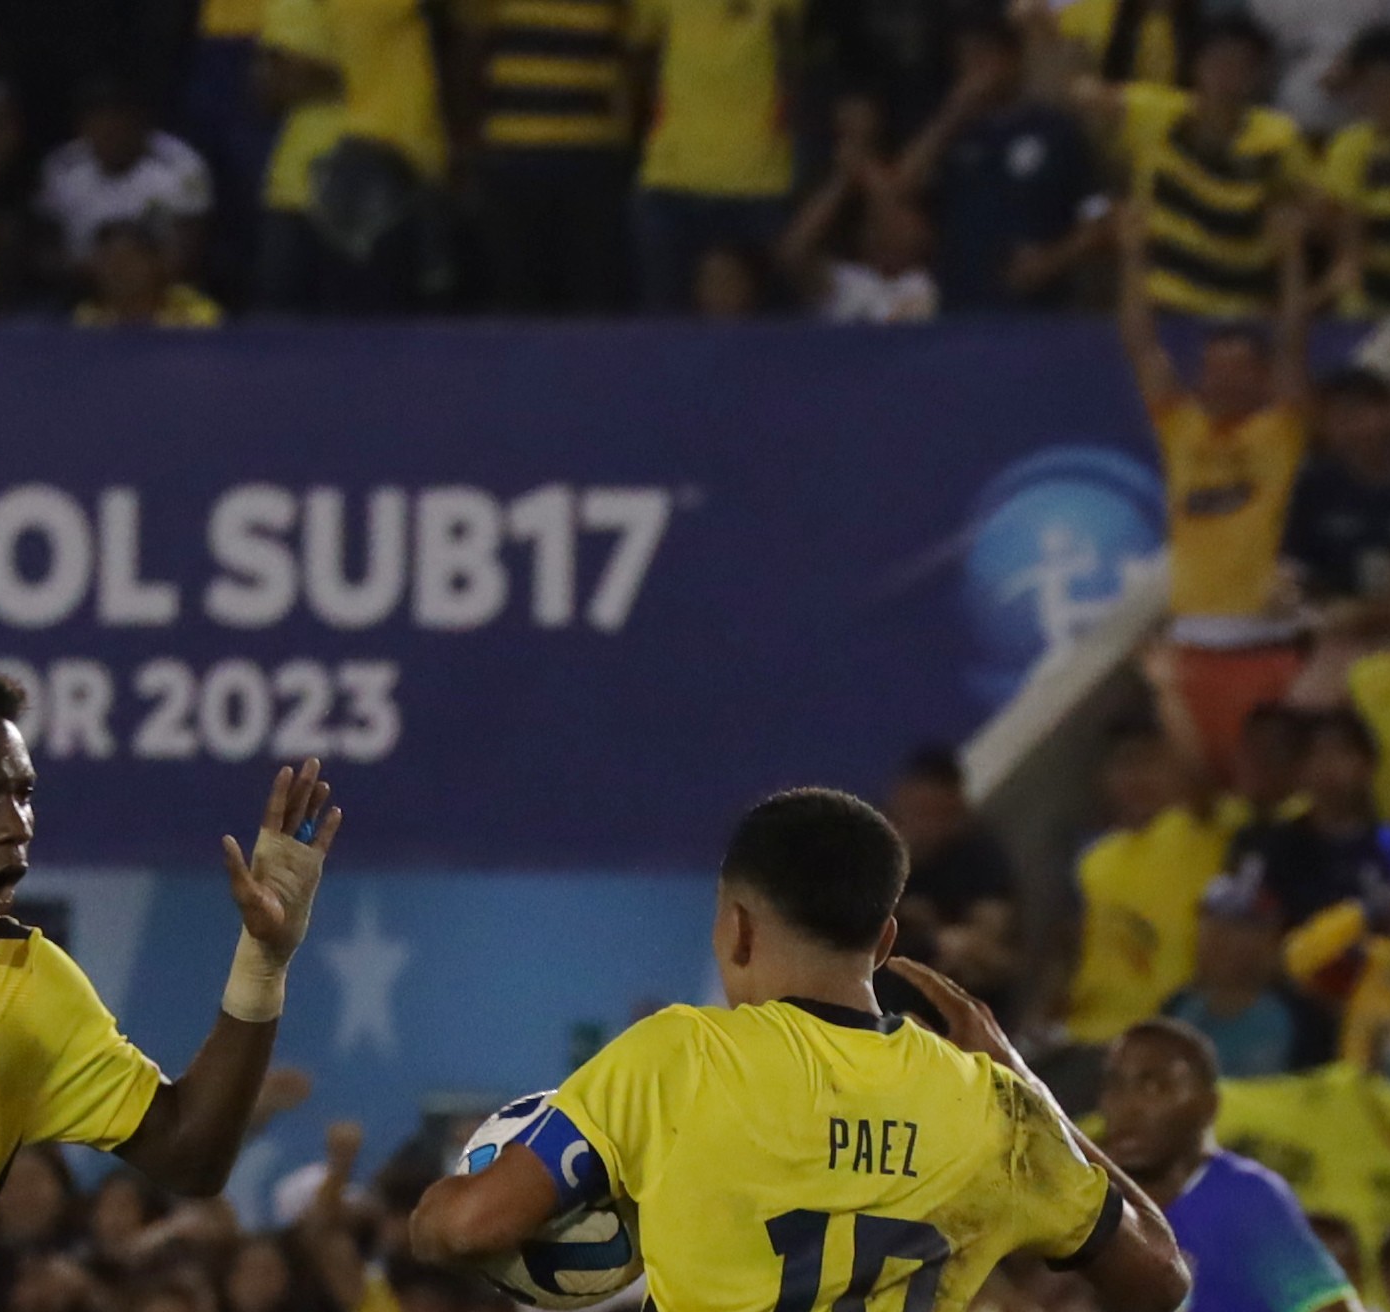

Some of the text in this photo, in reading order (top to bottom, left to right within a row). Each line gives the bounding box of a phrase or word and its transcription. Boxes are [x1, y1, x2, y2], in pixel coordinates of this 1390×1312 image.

[207, 482, 671, 631] SUB17
[134, 658, 401, 761] 2023
[829, 1117, 917, 1177] PAEZ
